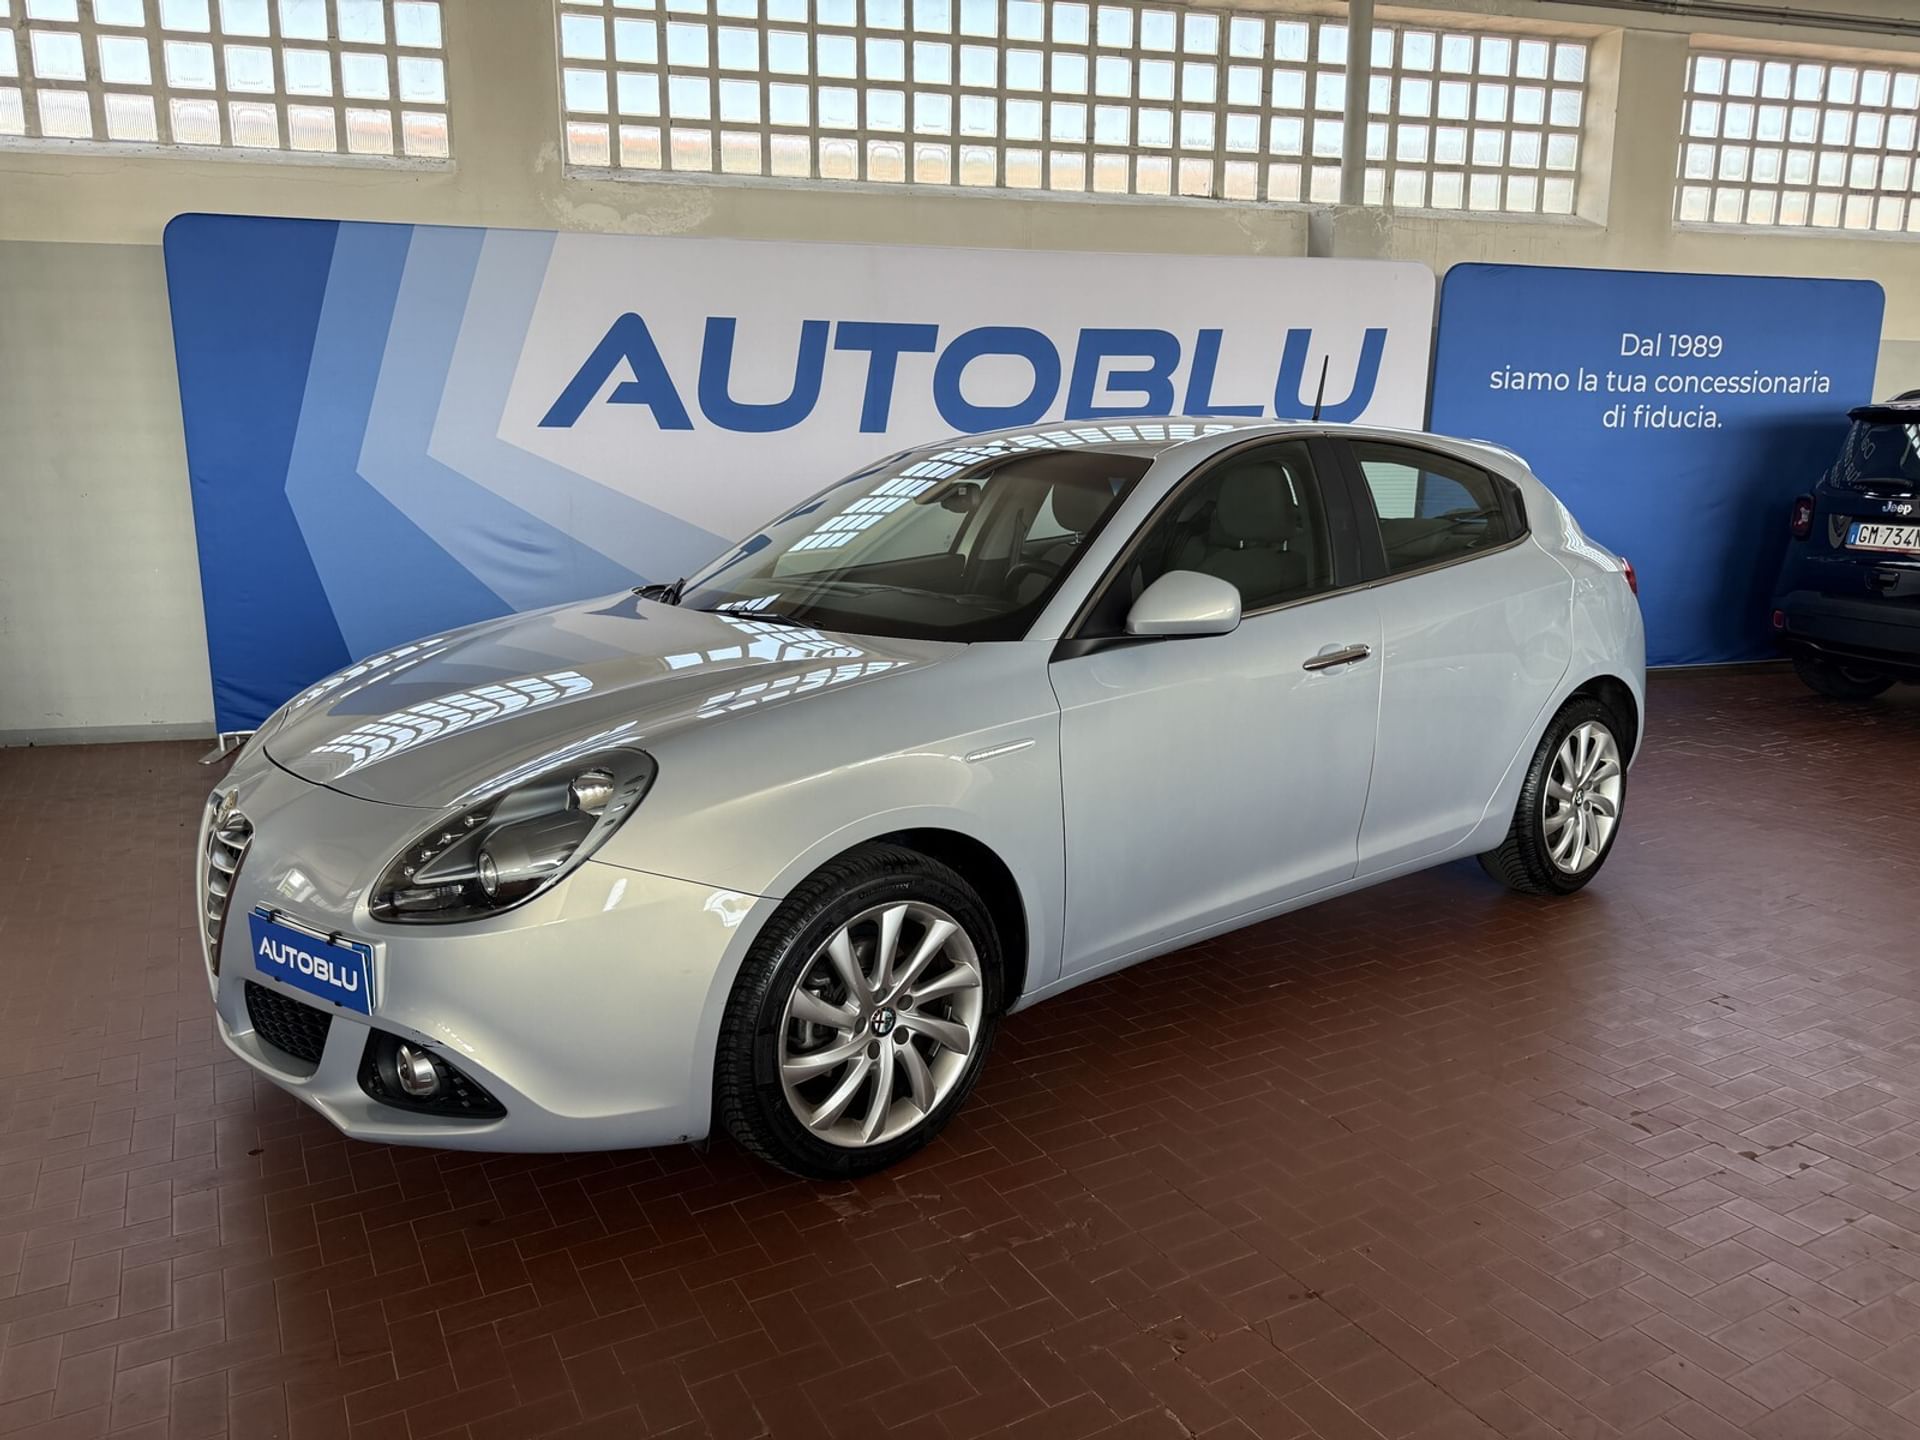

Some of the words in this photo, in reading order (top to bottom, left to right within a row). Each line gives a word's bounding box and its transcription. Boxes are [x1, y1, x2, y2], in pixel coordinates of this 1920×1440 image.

[1619, 333, 1661, 357] Dal
[1669, 334, 1723, 358] 1989
[537, 311, 1388, 434] AUTOBLU
[1489, 365, 1570, 391] siamo
[1577, 367, 1598, 392] la
[1606, 370, 1647, 393] tua
[1654, 369, 1831, 394] concessionaria
[1602, 404, 1627, 428] di
[1633, 404, 1723, 428] fiducia.
[1882, 501, 1912, 515] Jeep
[1858, 526, 1879, 544] GM
[258, 936, 358, 992] AUTOBLU
